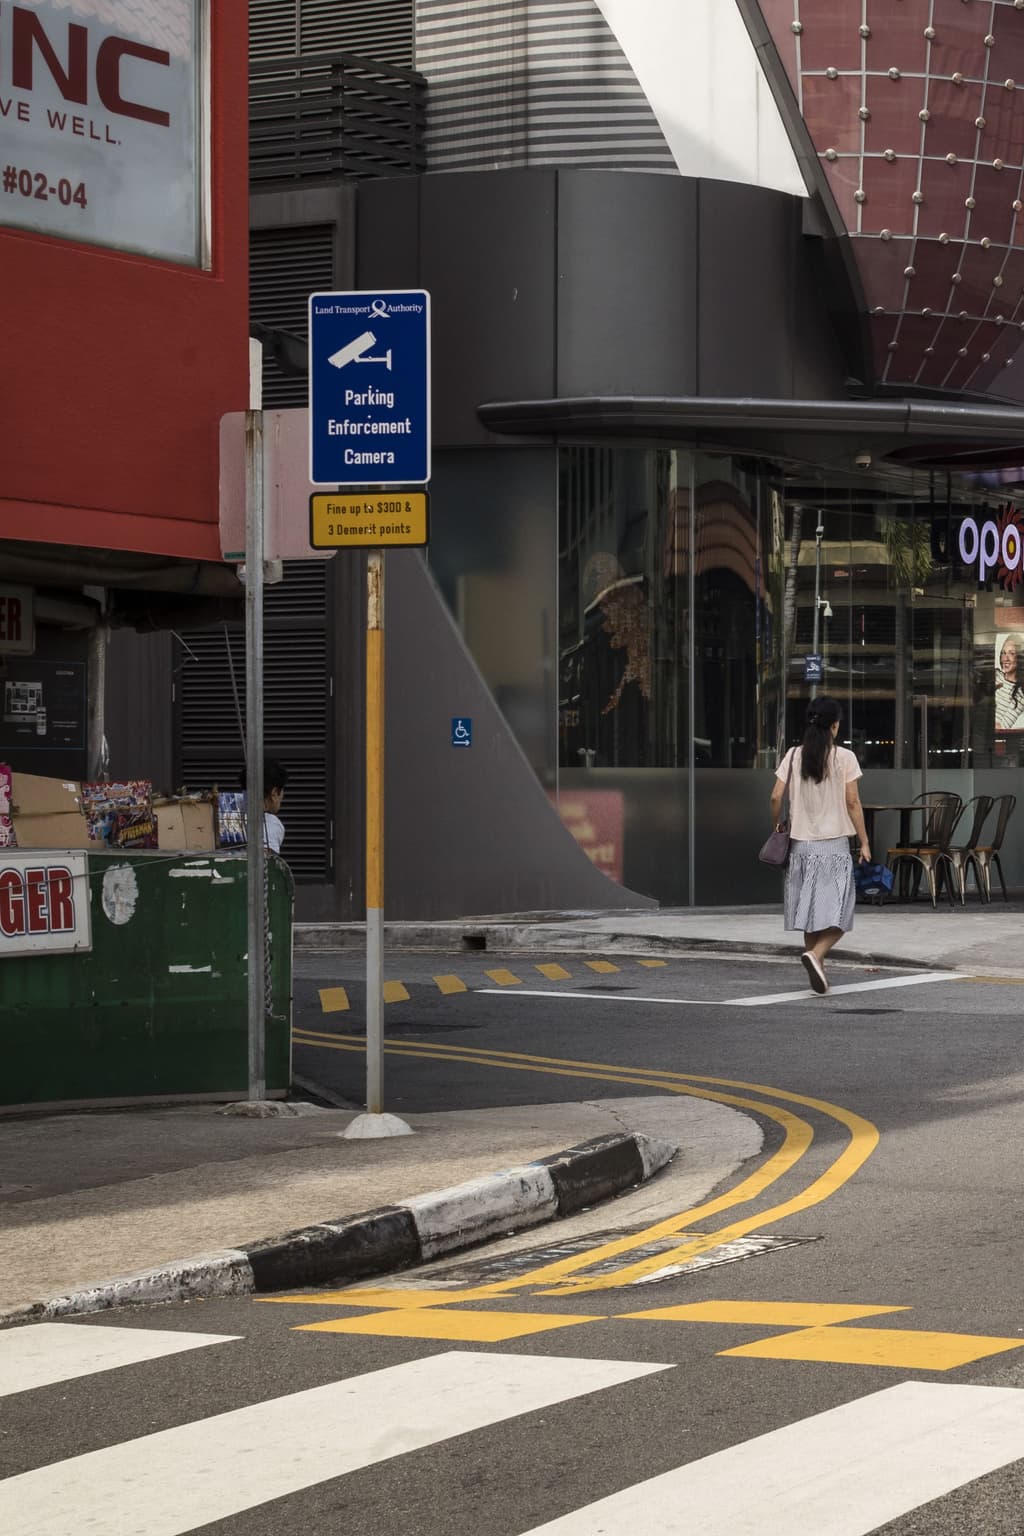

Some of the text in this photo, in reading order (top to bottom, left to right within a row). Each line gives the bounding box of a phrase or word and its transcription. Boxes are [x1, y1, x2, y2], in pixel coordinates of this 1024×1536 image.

[0, 5, 170, 128] NC
[3, 165, 88, 209] #02-04
[315, 303, 423, 315] Land Transport Authority
[345, 388, 394, 408] Parking
[328, 418, 411, 436] Enforcement
[344, 449, 395, 464] Camera
[327, 501, 412, 517] Fine up to $300 &
[328, 523, 411, 537] 3 Demerit points
[0, 866, 76, 938] GER
